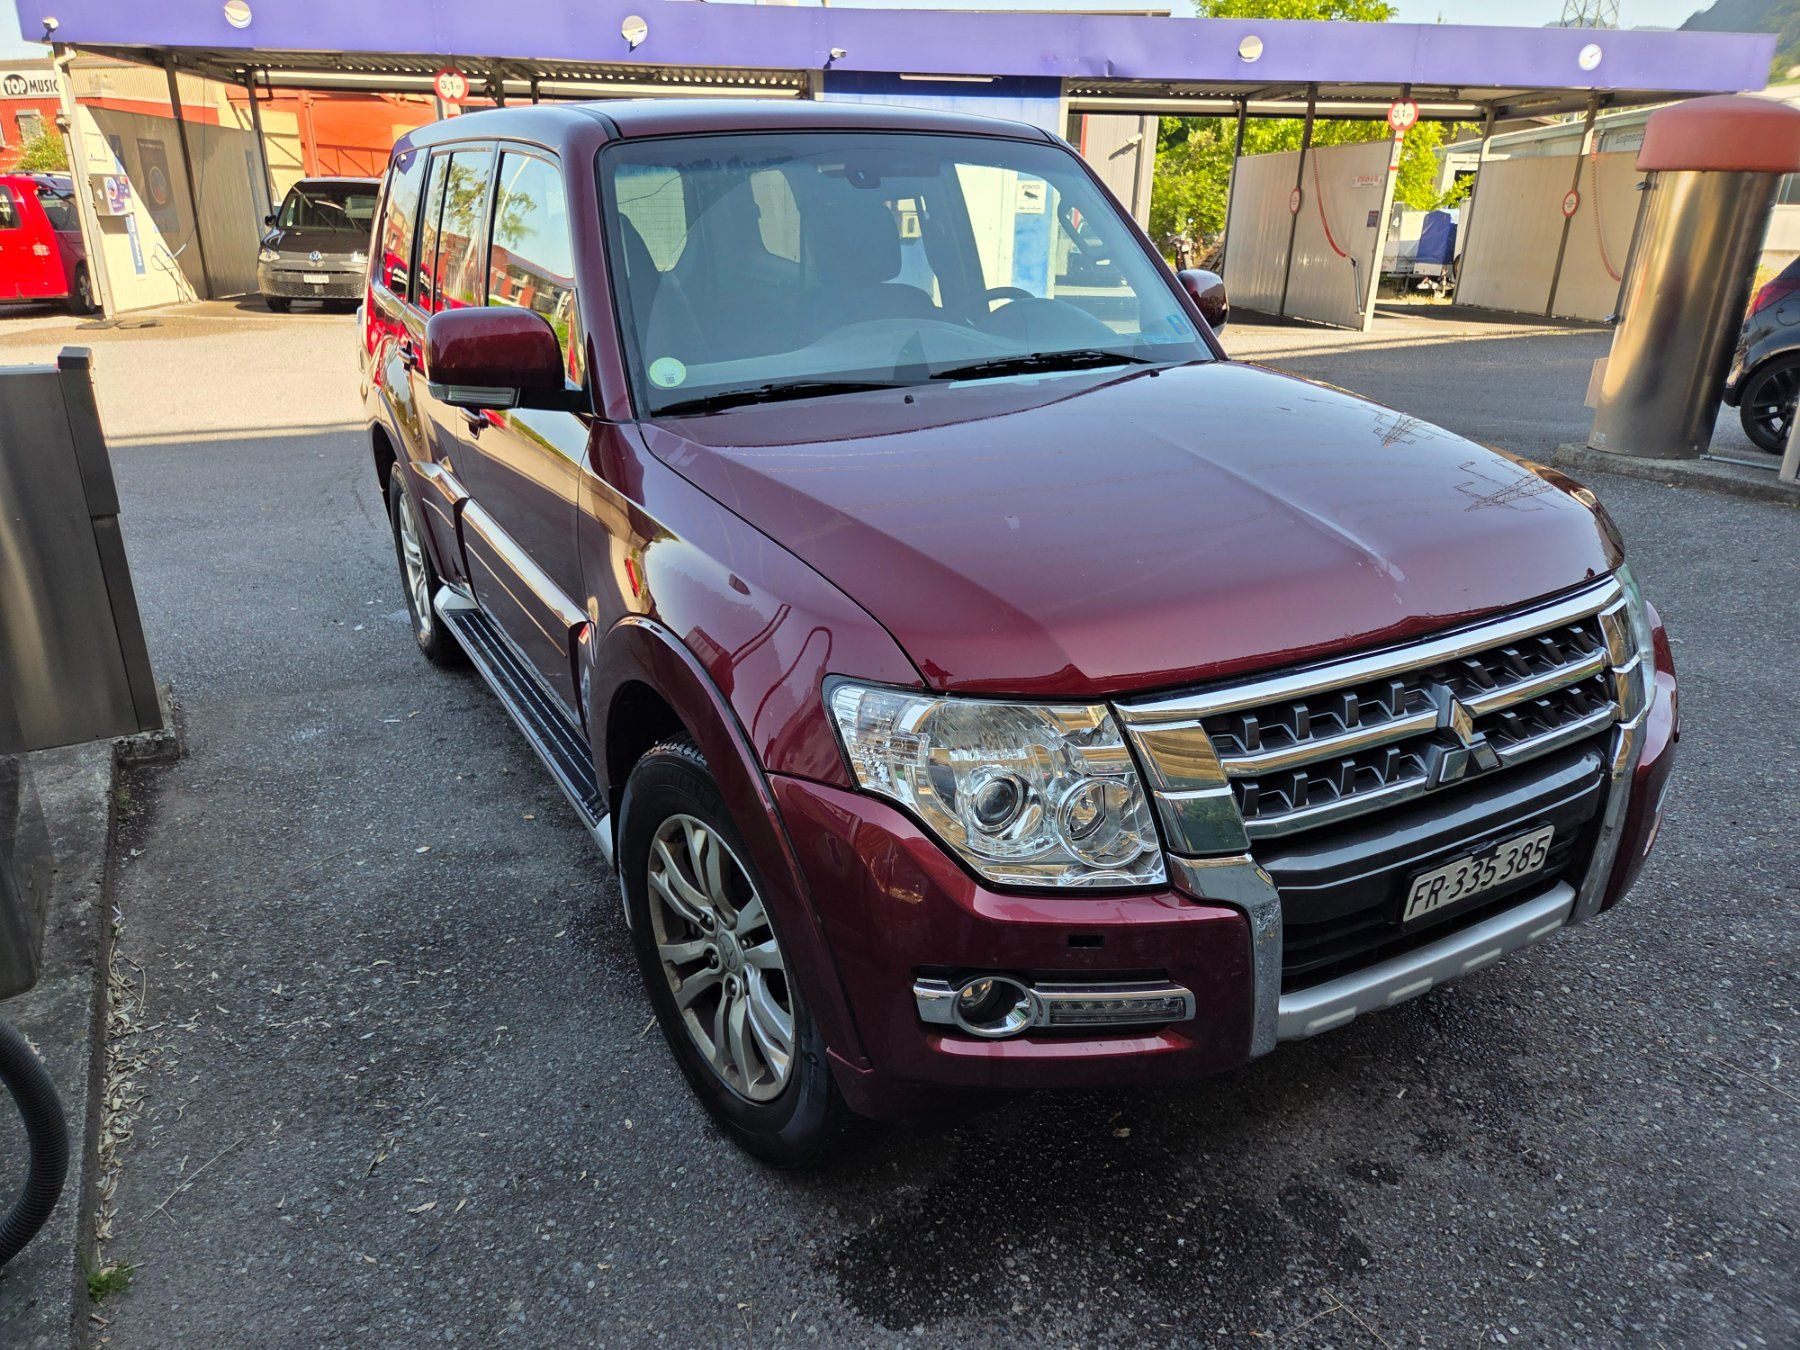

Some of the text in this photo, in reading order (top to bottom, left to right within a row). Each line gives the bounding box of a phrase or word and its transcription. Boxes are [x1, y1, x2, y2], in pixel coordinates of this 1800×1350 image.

[4, 79, 60, 95] TOP MUSIC
[1392, 216, 1400, 228] 4
